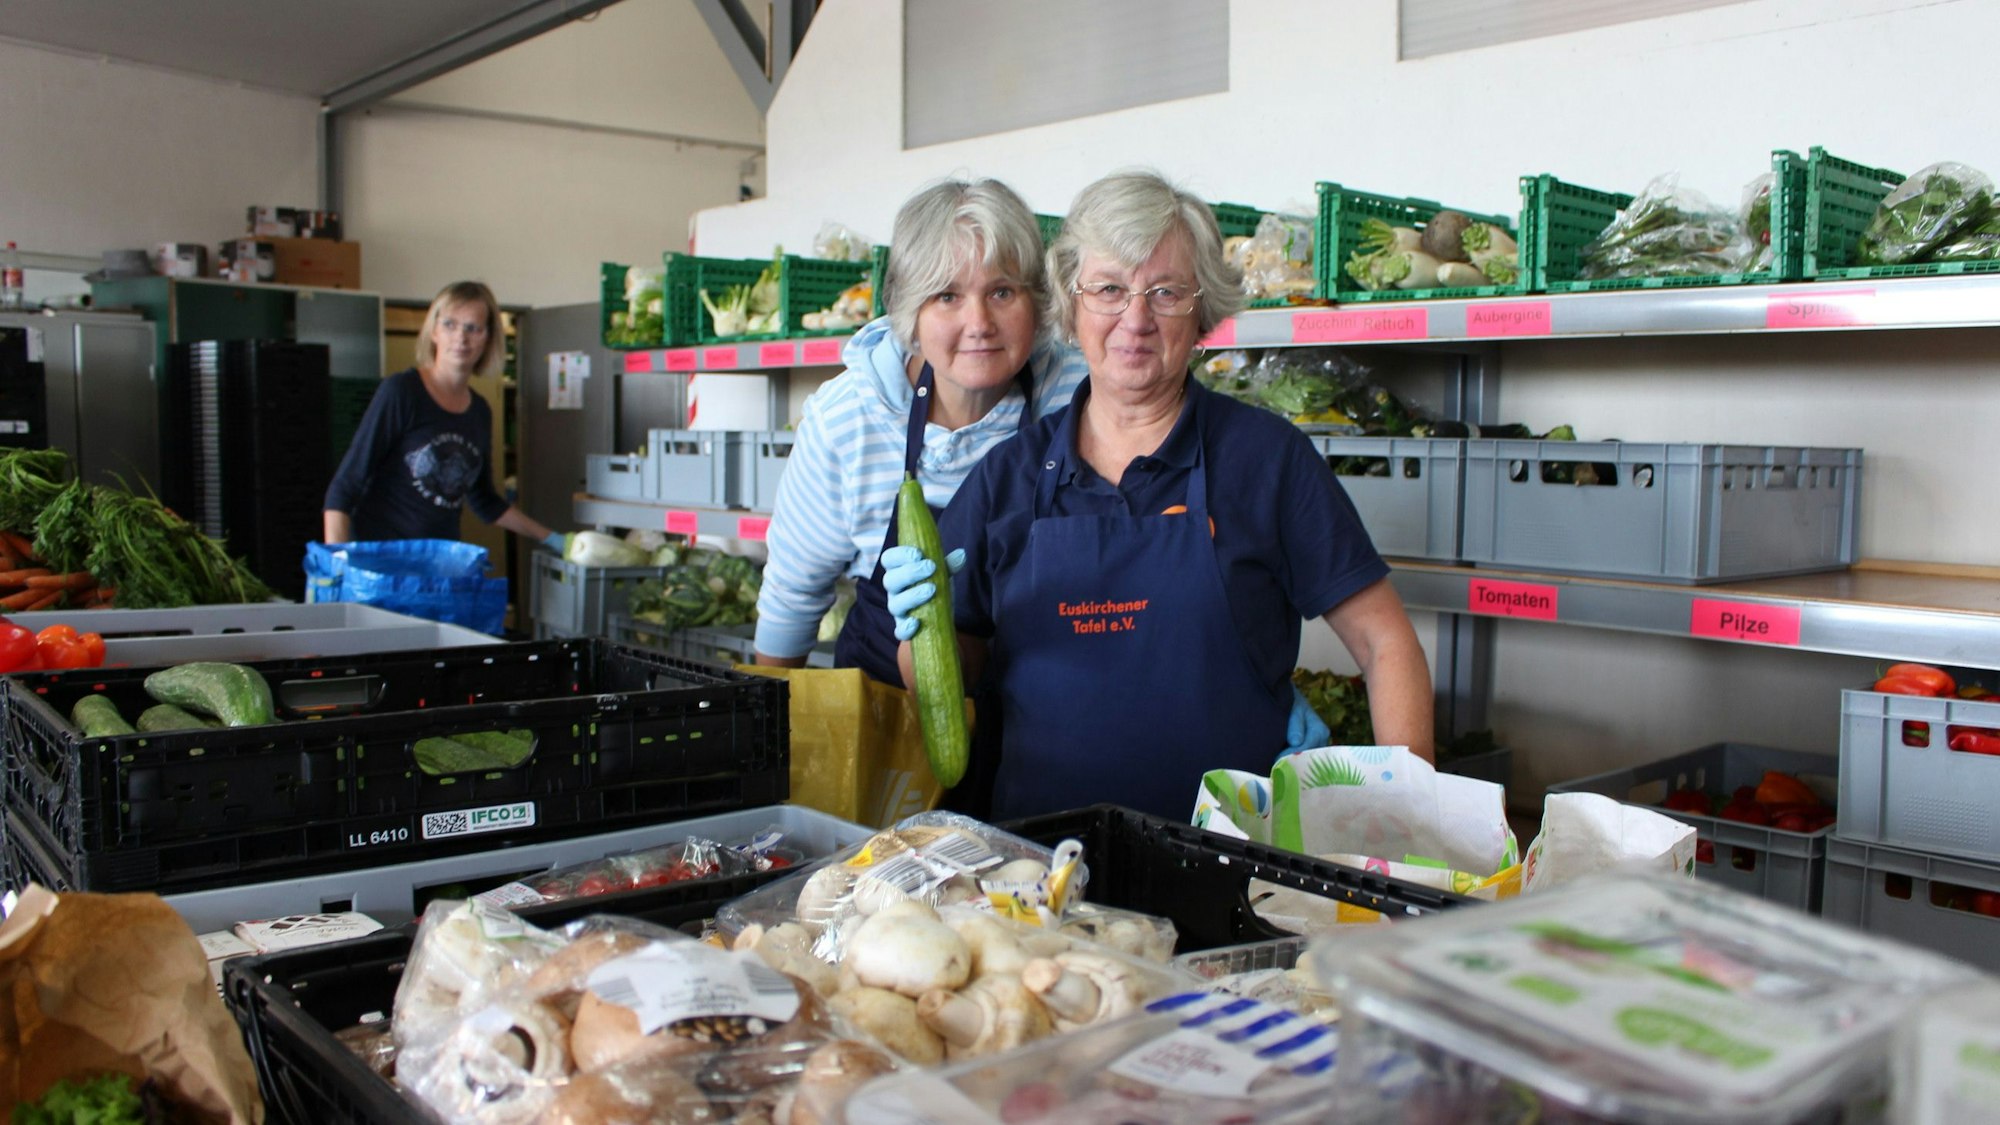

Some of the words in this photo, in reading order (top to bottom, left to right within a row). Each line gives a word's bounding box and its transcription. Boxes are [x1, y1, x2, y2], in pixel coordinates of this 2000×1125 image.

[1298, 316, 1356, 330] Zucchini
[1363, 315, 1414, 331] Rettich
[1473, 309, 1543, 324] Aubergine
[1477, 586, 1550, 609] Tomaten
[1058, 599, 1149, 616] Euskirchener
[1072, 618, 1106, 633] Tafel
[1110, 616, 1135, 632] e.V.
[1720, 612, 1769, 635] Pilze
[471, 808, 511, 824] IFCO
[349, 834, 367, 847] LL
[370, 827, 408, 845] 6410
